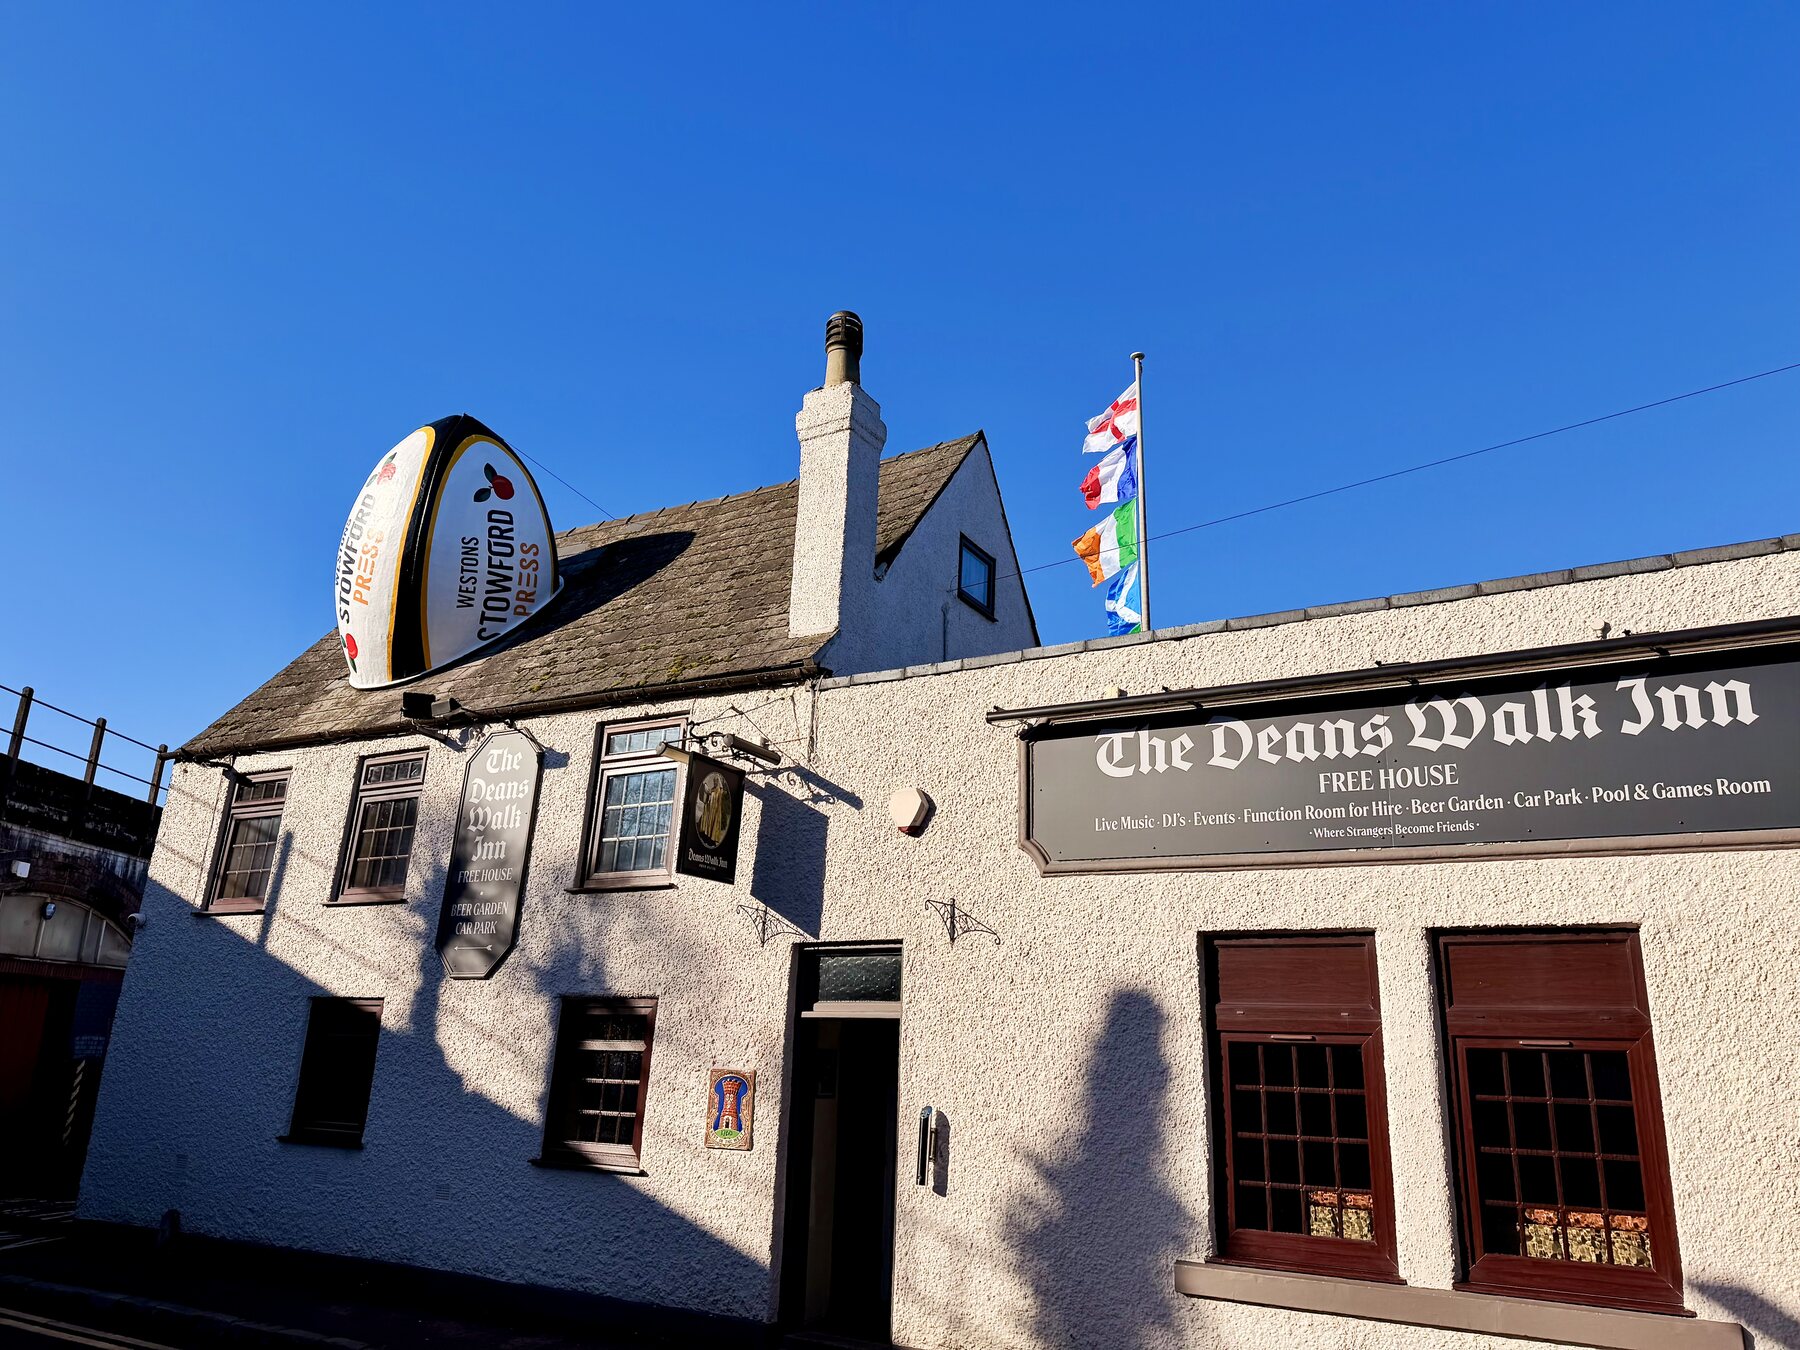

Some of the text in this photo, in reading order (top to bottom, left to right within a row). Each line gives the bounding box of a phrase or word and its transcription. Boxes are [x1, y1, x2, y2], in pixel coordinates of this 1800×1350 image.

[353, 526, 384, 606] PRESS
[456, 536, 479, 609] WESTONS
[477, 509, 514, 641] STOWFORD
[513, 542, 539, 616] PRESS
[1094, 672, 1760, 778] The Deans Walk Inn
[486, 747, 523, 774] The
[468, 778, 529, 804] Deans
[1318, 763, 1459, 793] FREE HOUSE
[467, 802, 521, 832] Walk
[1094, 777, 1772, 832] Live Music DJ's Events Function Room for Hire Beer Garden Car Park Pool & Games Room
[1346, 825, 1393, 841] Strangers
[1395, 823, 1435, 837] Become
[471, 835, 506, 862] Inn
[458, 867, 513, 883] FREE HOUSE
[451, 901, 508, 916] BEER GARDEN
[455, 921, 497, 935] CAR PARK
